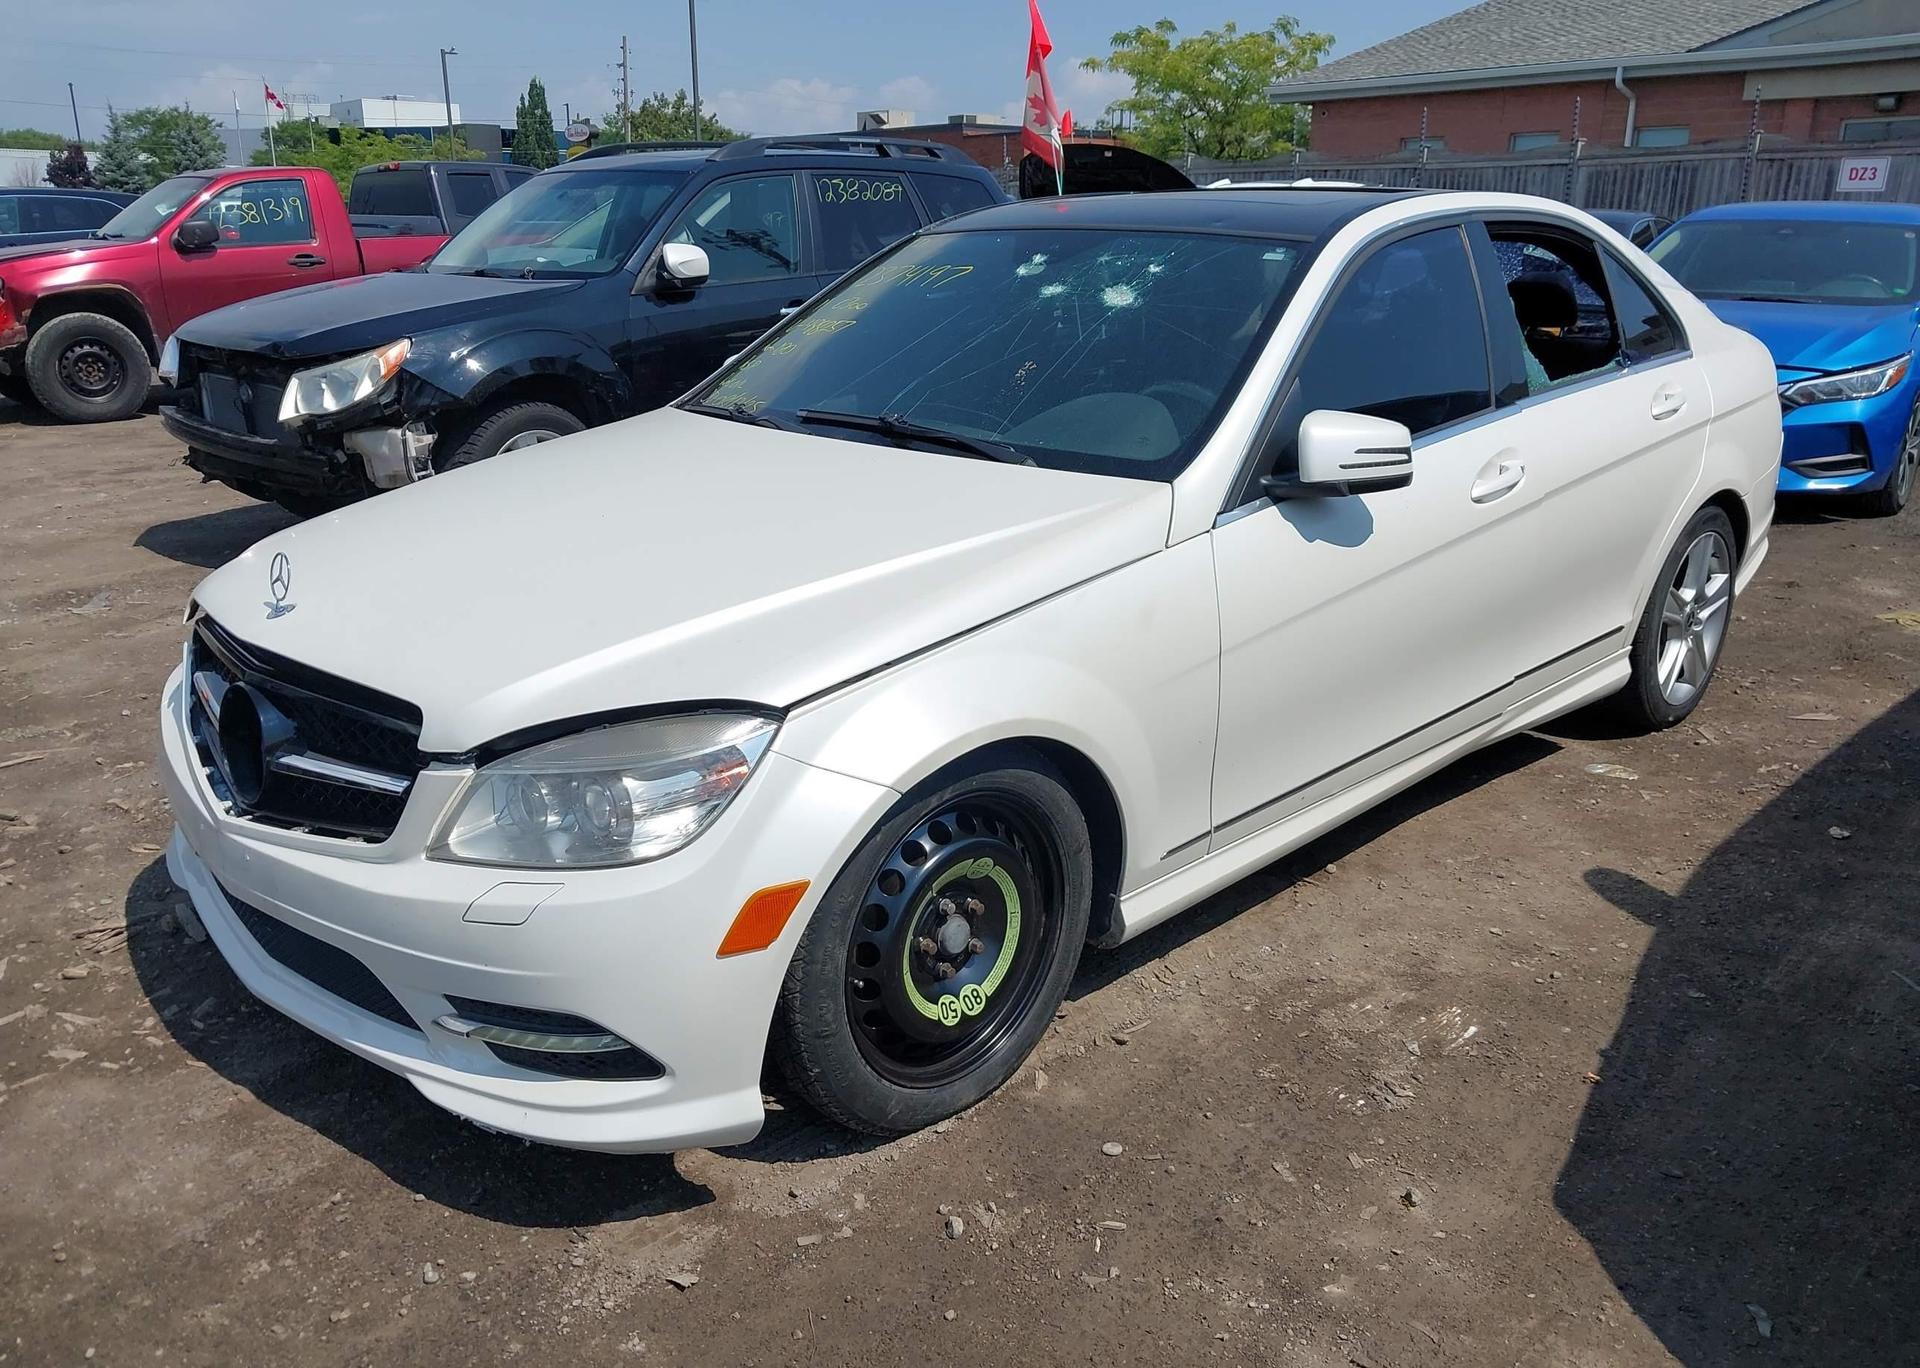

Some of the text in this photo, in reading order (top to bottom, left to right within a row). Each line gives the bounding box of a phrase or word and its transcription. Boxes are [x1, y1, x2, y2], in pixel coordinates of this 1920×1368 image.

[1848, 166, 1878, 181] DZ3
[814, 178, 902, 203] 12382089
[940, 1000, 959, 1020] 50
[962, 988, 983, 1012] 80
